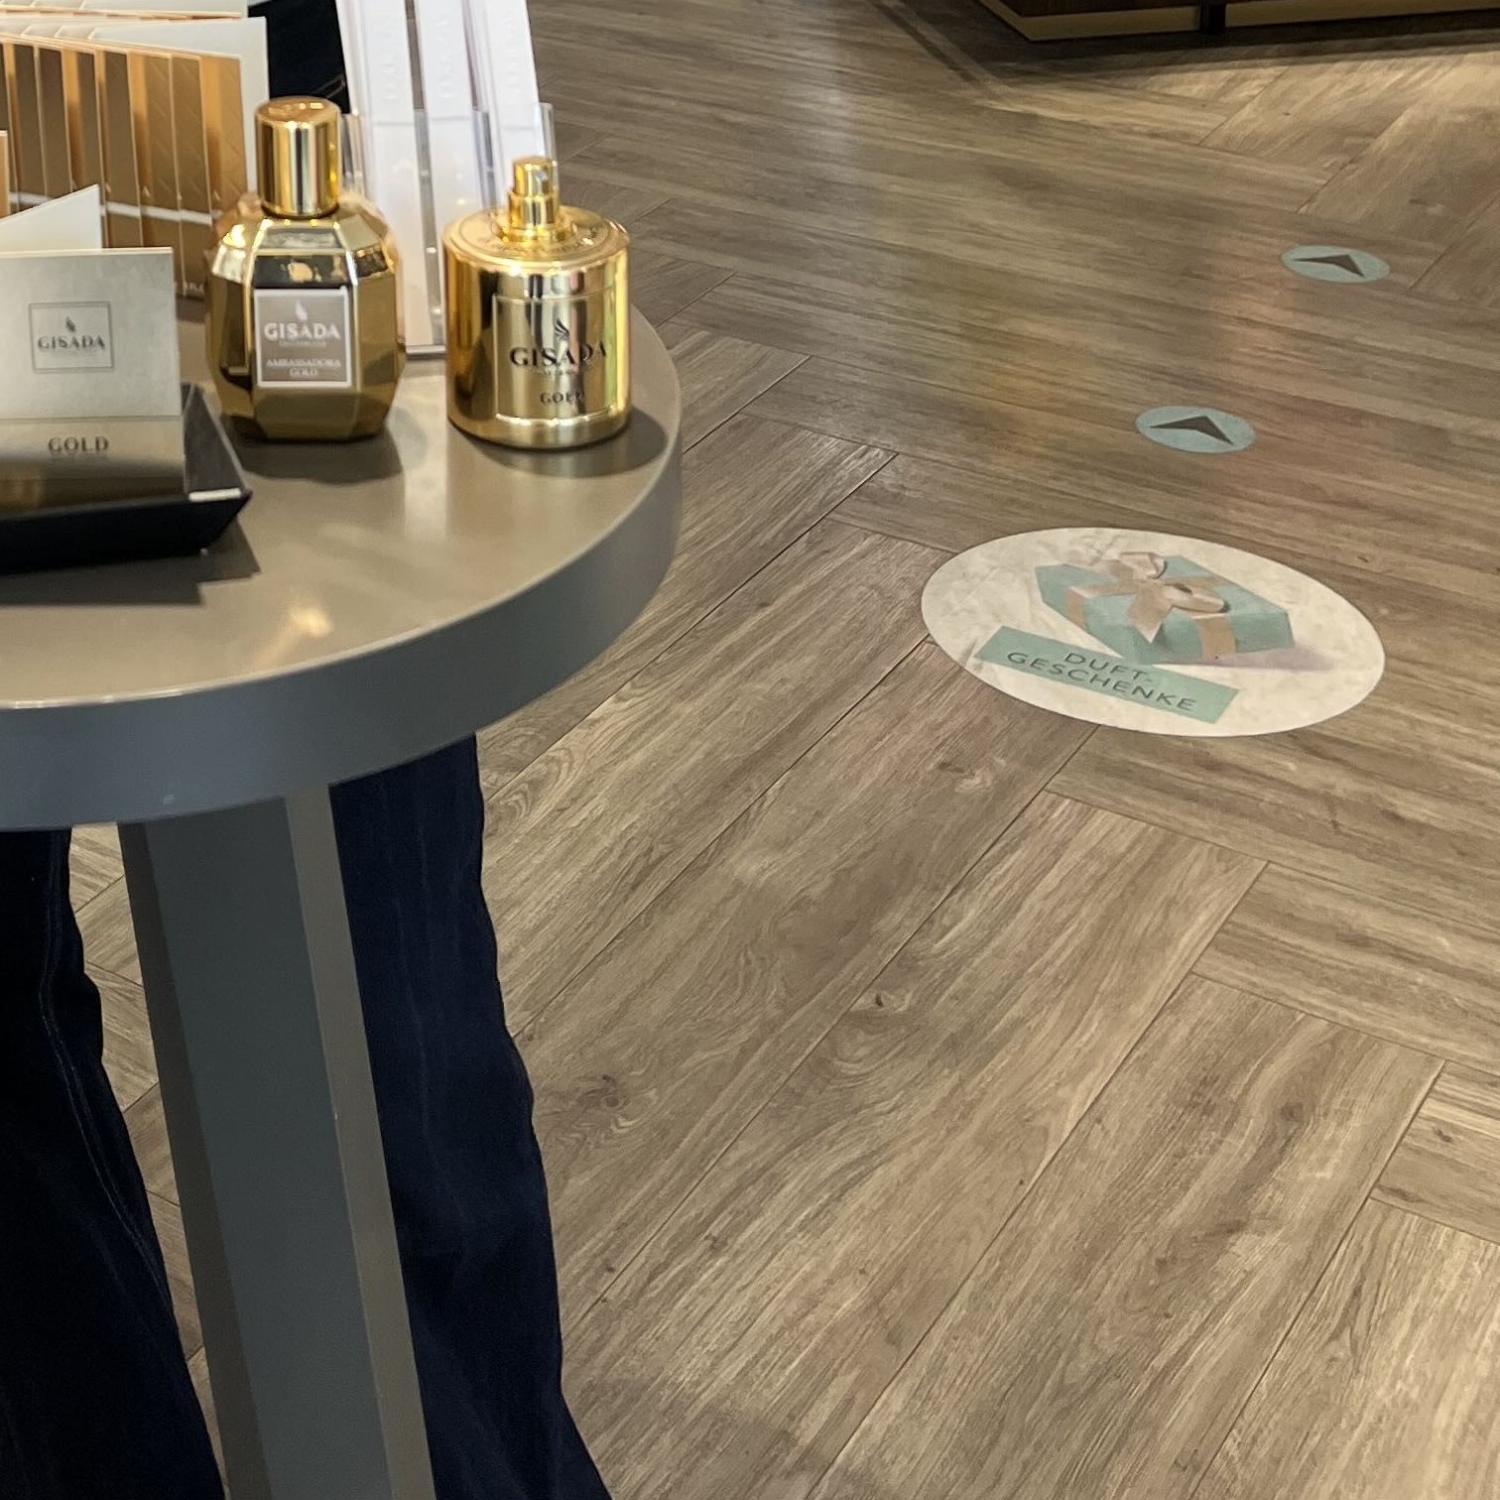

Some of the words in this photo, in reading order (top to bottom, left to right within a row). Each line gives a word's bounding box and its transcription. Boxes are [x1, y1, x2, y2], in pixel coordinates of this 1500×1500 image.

[263, 322, 341, 342] GISADA
[36, 334, 106, 351] GISADA
[509, 341, 607, 368] GISADA
[540, 391, 586, 405] GOLD
[47, 436, 110, 453] GOLD
[1063, 651, 1154, 683] DUFT-
[1006, 651, 1197, 713] GESCHENKE
